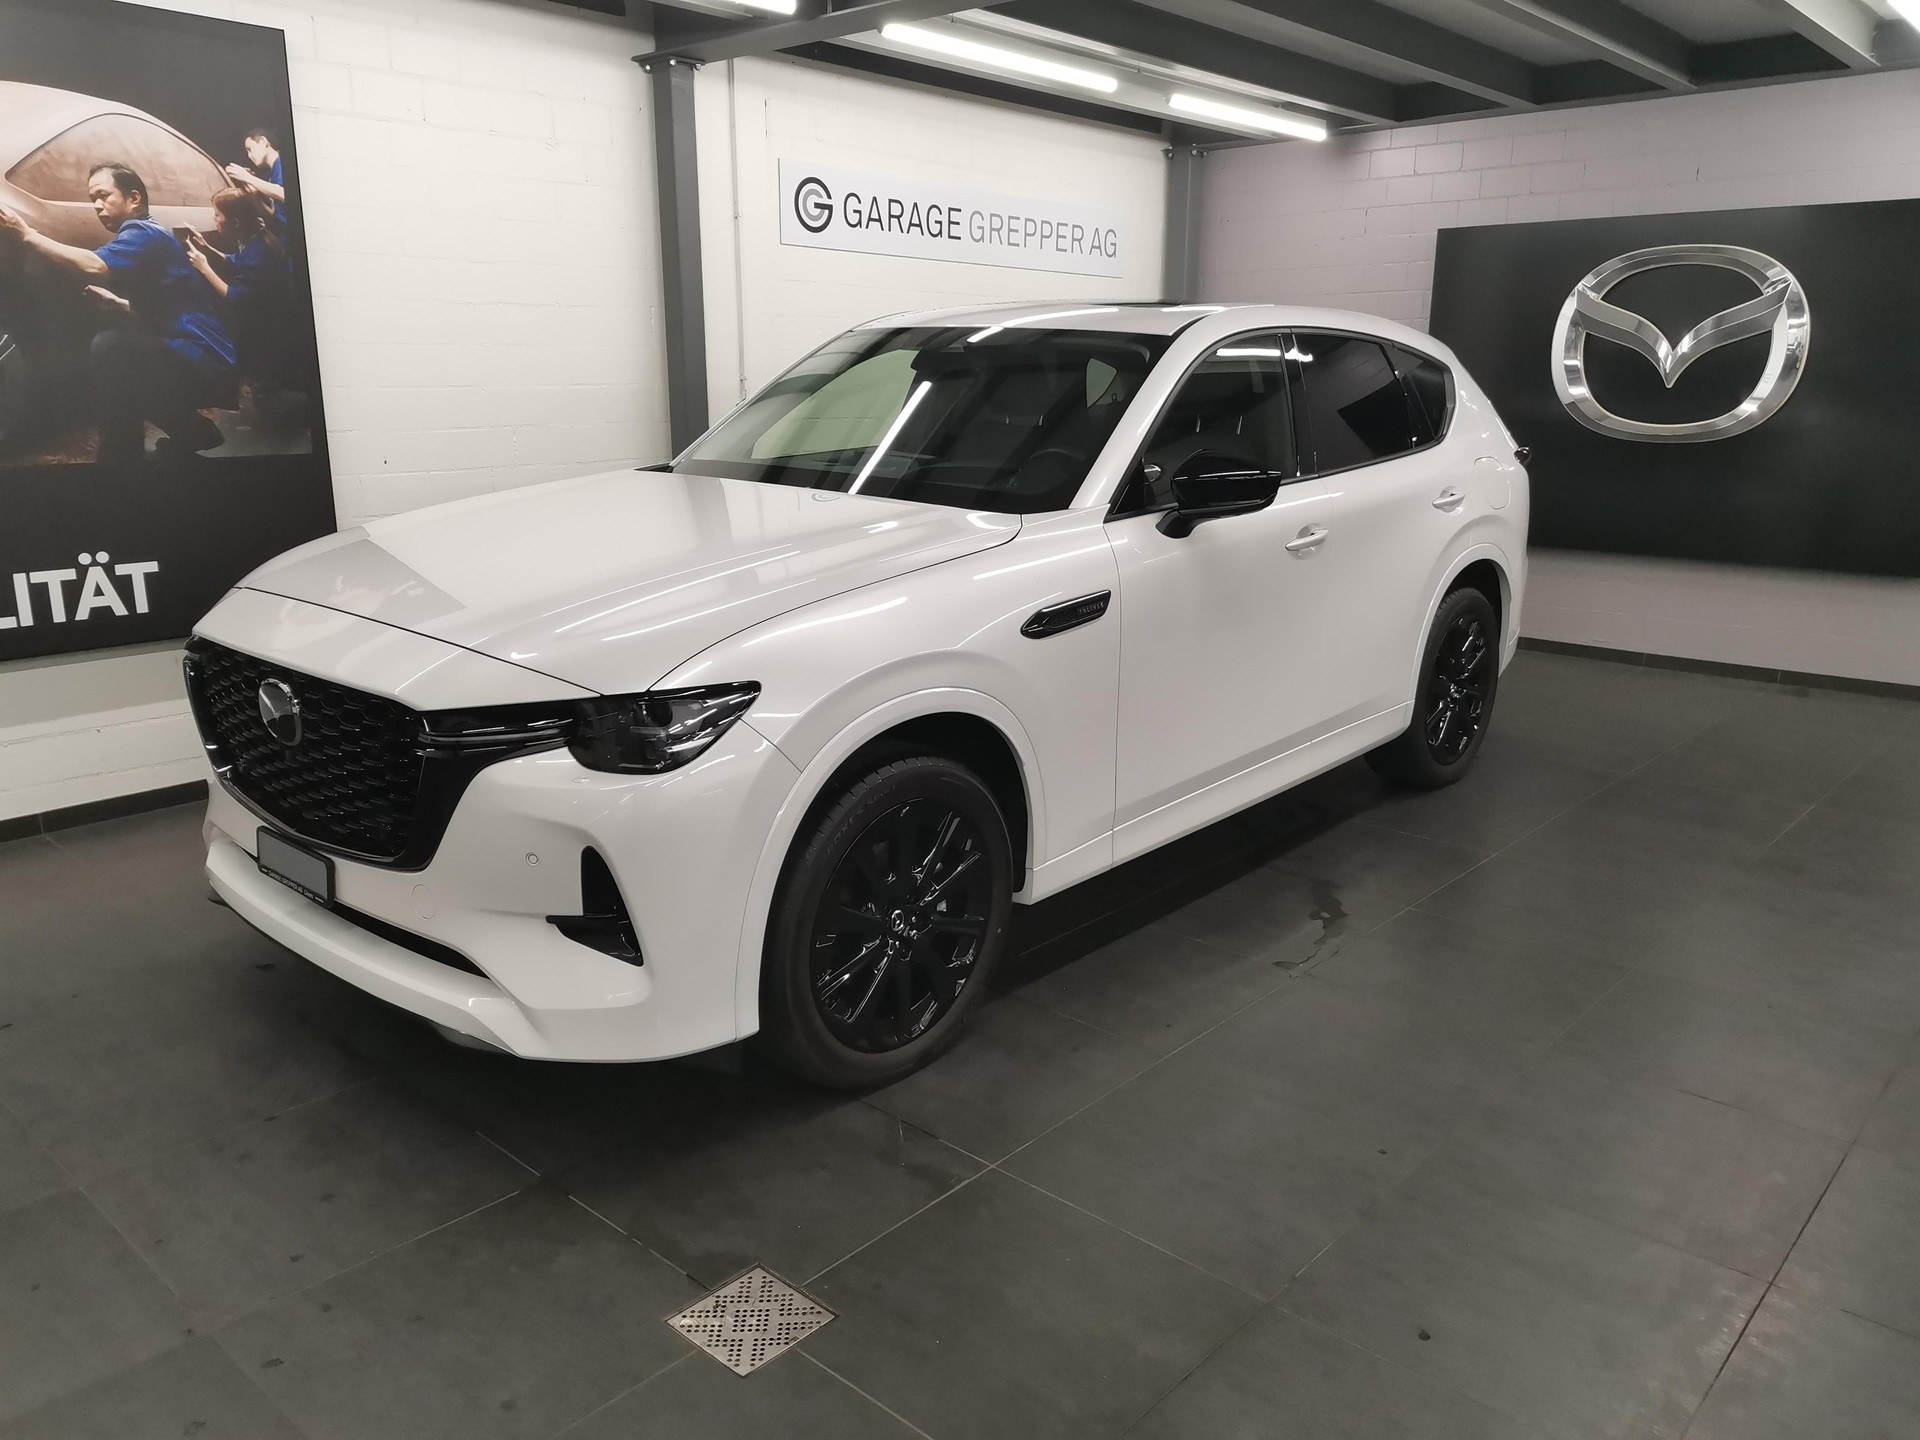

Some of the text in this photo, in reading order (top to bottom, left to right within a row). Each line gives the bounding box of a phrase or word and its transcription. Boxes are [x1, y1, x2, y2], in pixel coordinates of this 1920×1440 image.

[843, 192, 1117, 259] GARAGE GREPPER AG
